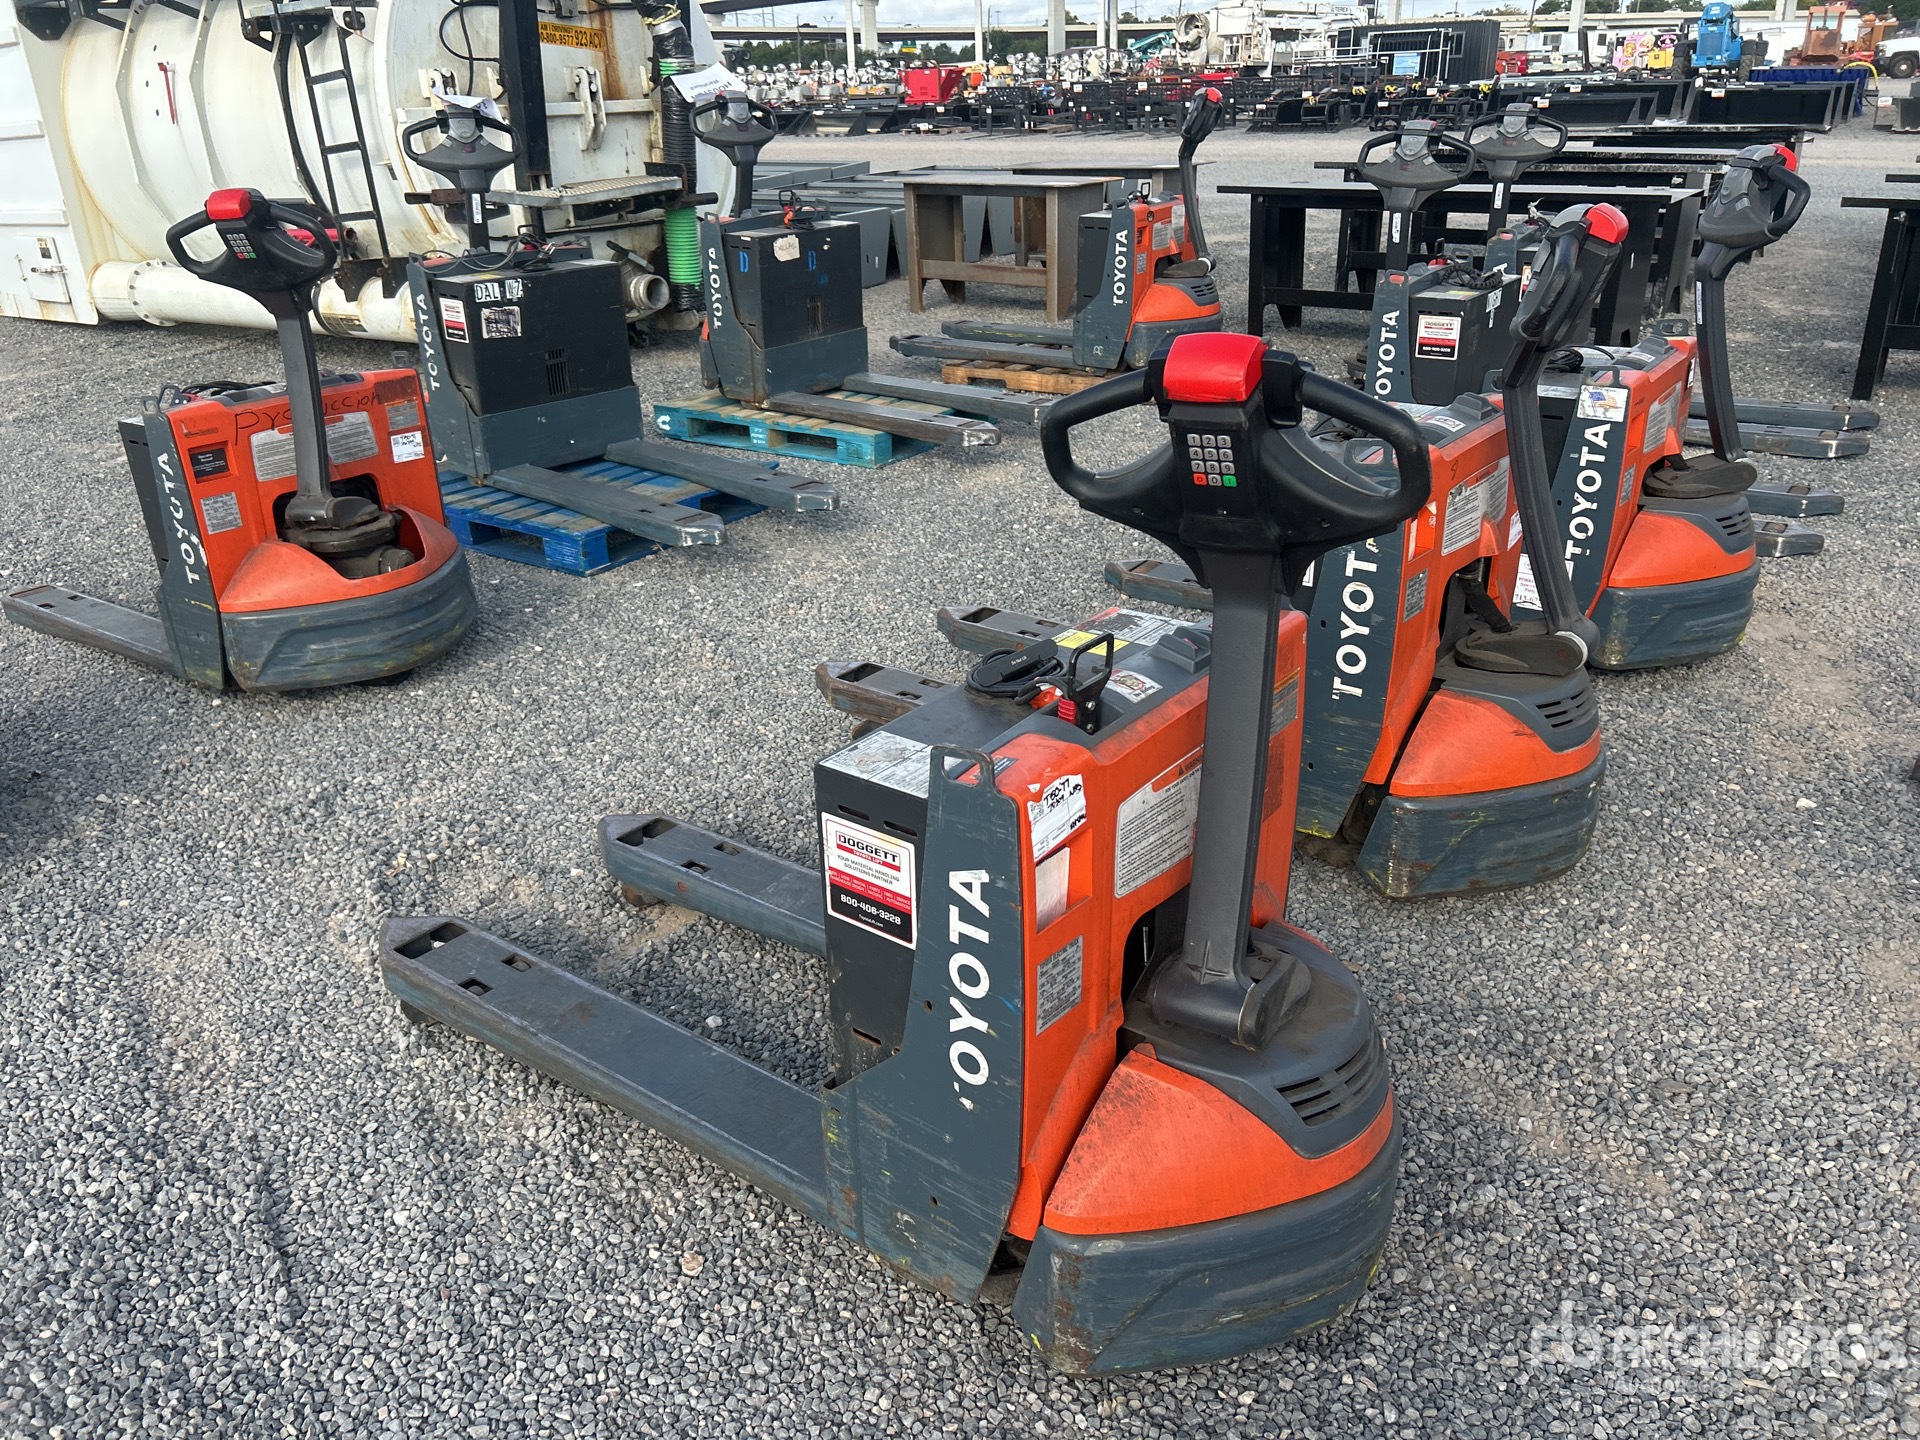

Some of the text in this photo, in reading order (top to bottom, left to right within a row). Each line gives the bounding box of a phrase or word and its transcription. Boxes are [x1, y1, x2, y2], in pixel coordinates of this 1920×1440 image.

[476, 284, 499, 300] DAL
[708, 247, 722, 330] TOYOTA
[1113, 229, 1128, 306] TOYOTA
[416, 293, 440, 391] TOYOTA
[1374, 310, 1400, 399] OYOTA
[1565, 423, 1611, 559] TOYOTA
[1184, 755, 1203, 772] WARN
[837, 854, 900, 882] YOUR MATERIAL HANDLING
[838, 834, 898, 862] DOGGETT
[844, 863, 893, 885] SOLUTIONS PARTNER
[950, 870, 990, 1111] OYOTA
